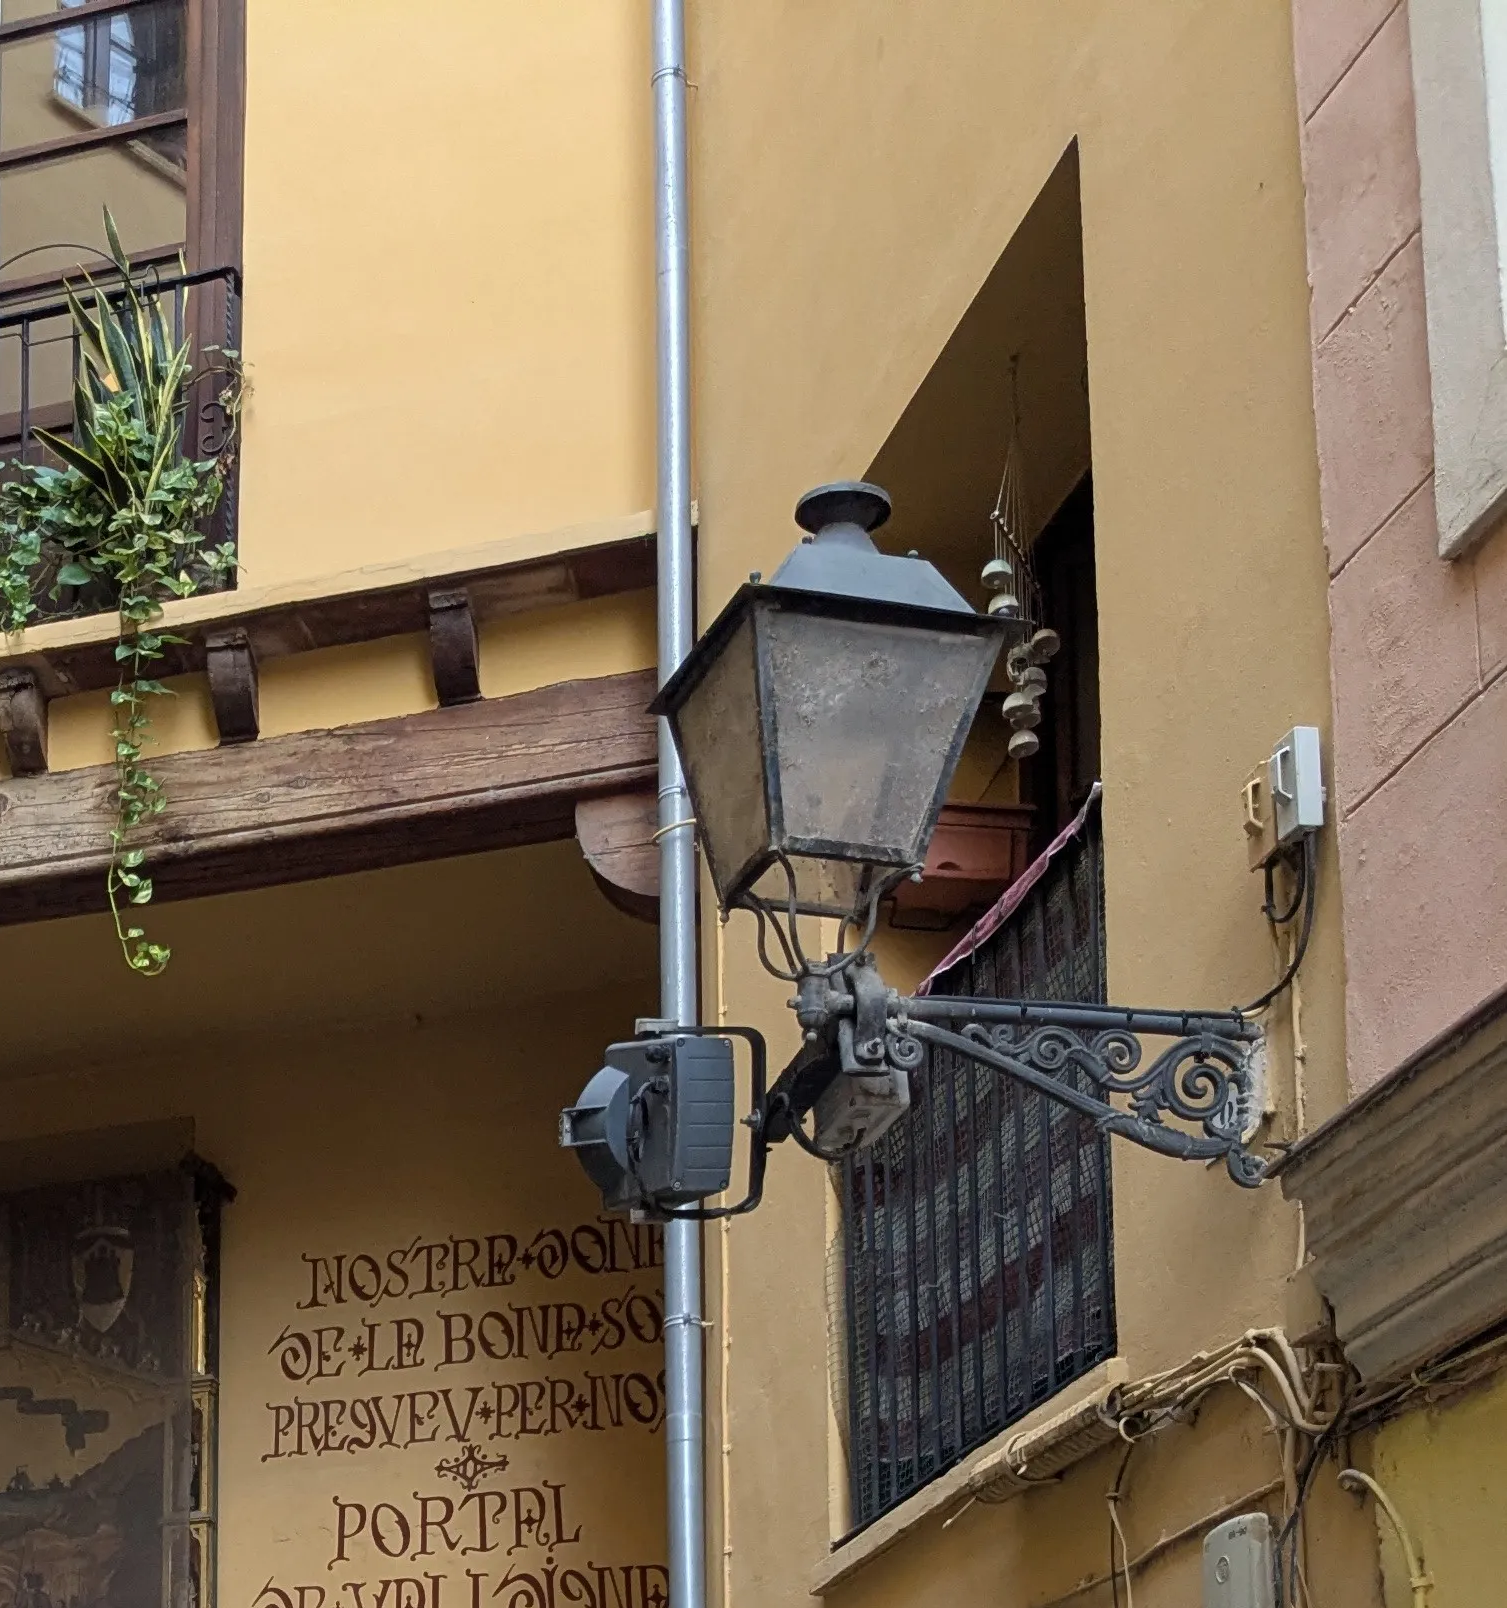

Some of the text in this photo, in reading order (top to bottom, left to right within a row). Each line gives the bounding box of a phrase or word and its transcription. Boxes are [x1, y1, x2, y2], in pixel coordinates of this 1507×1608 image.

[268, 1325, 346, 1385] DE
[591, 1285, 665, 1356] SO
[488, 1374, 576, 1440] PER
[327, 1481, 583, 1570] PORTAL
